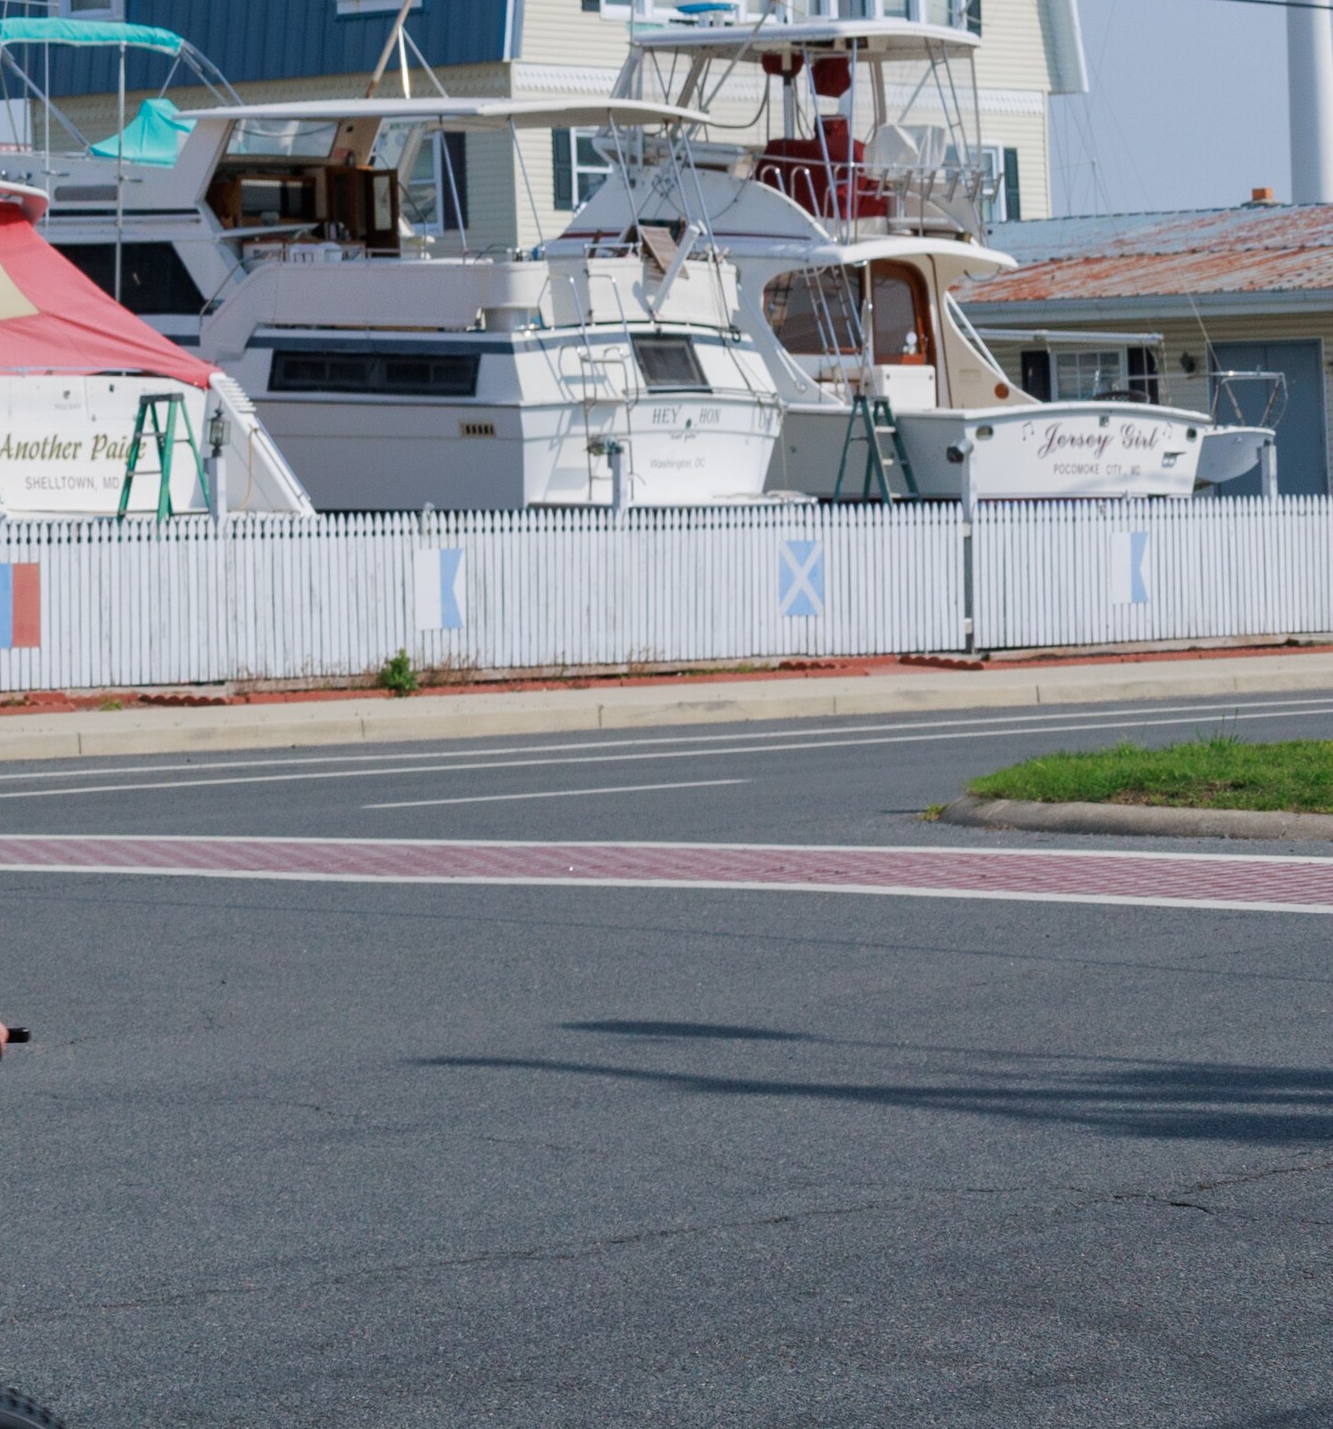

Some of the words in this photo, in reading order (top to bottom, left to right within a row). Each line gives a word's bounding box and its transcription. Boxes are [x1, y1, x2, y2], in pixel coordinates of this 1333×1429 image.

[699, 408, 721, 424] HON
[1038, 423, 1113, 459] Jersey
[1120, 424, 1160, 450] Girl
[1053, 463, 1100, 475] POCOMOKE
[24, 476, 99, 491] SHELLTOWN,
[103, 476, 120, 489] MD
